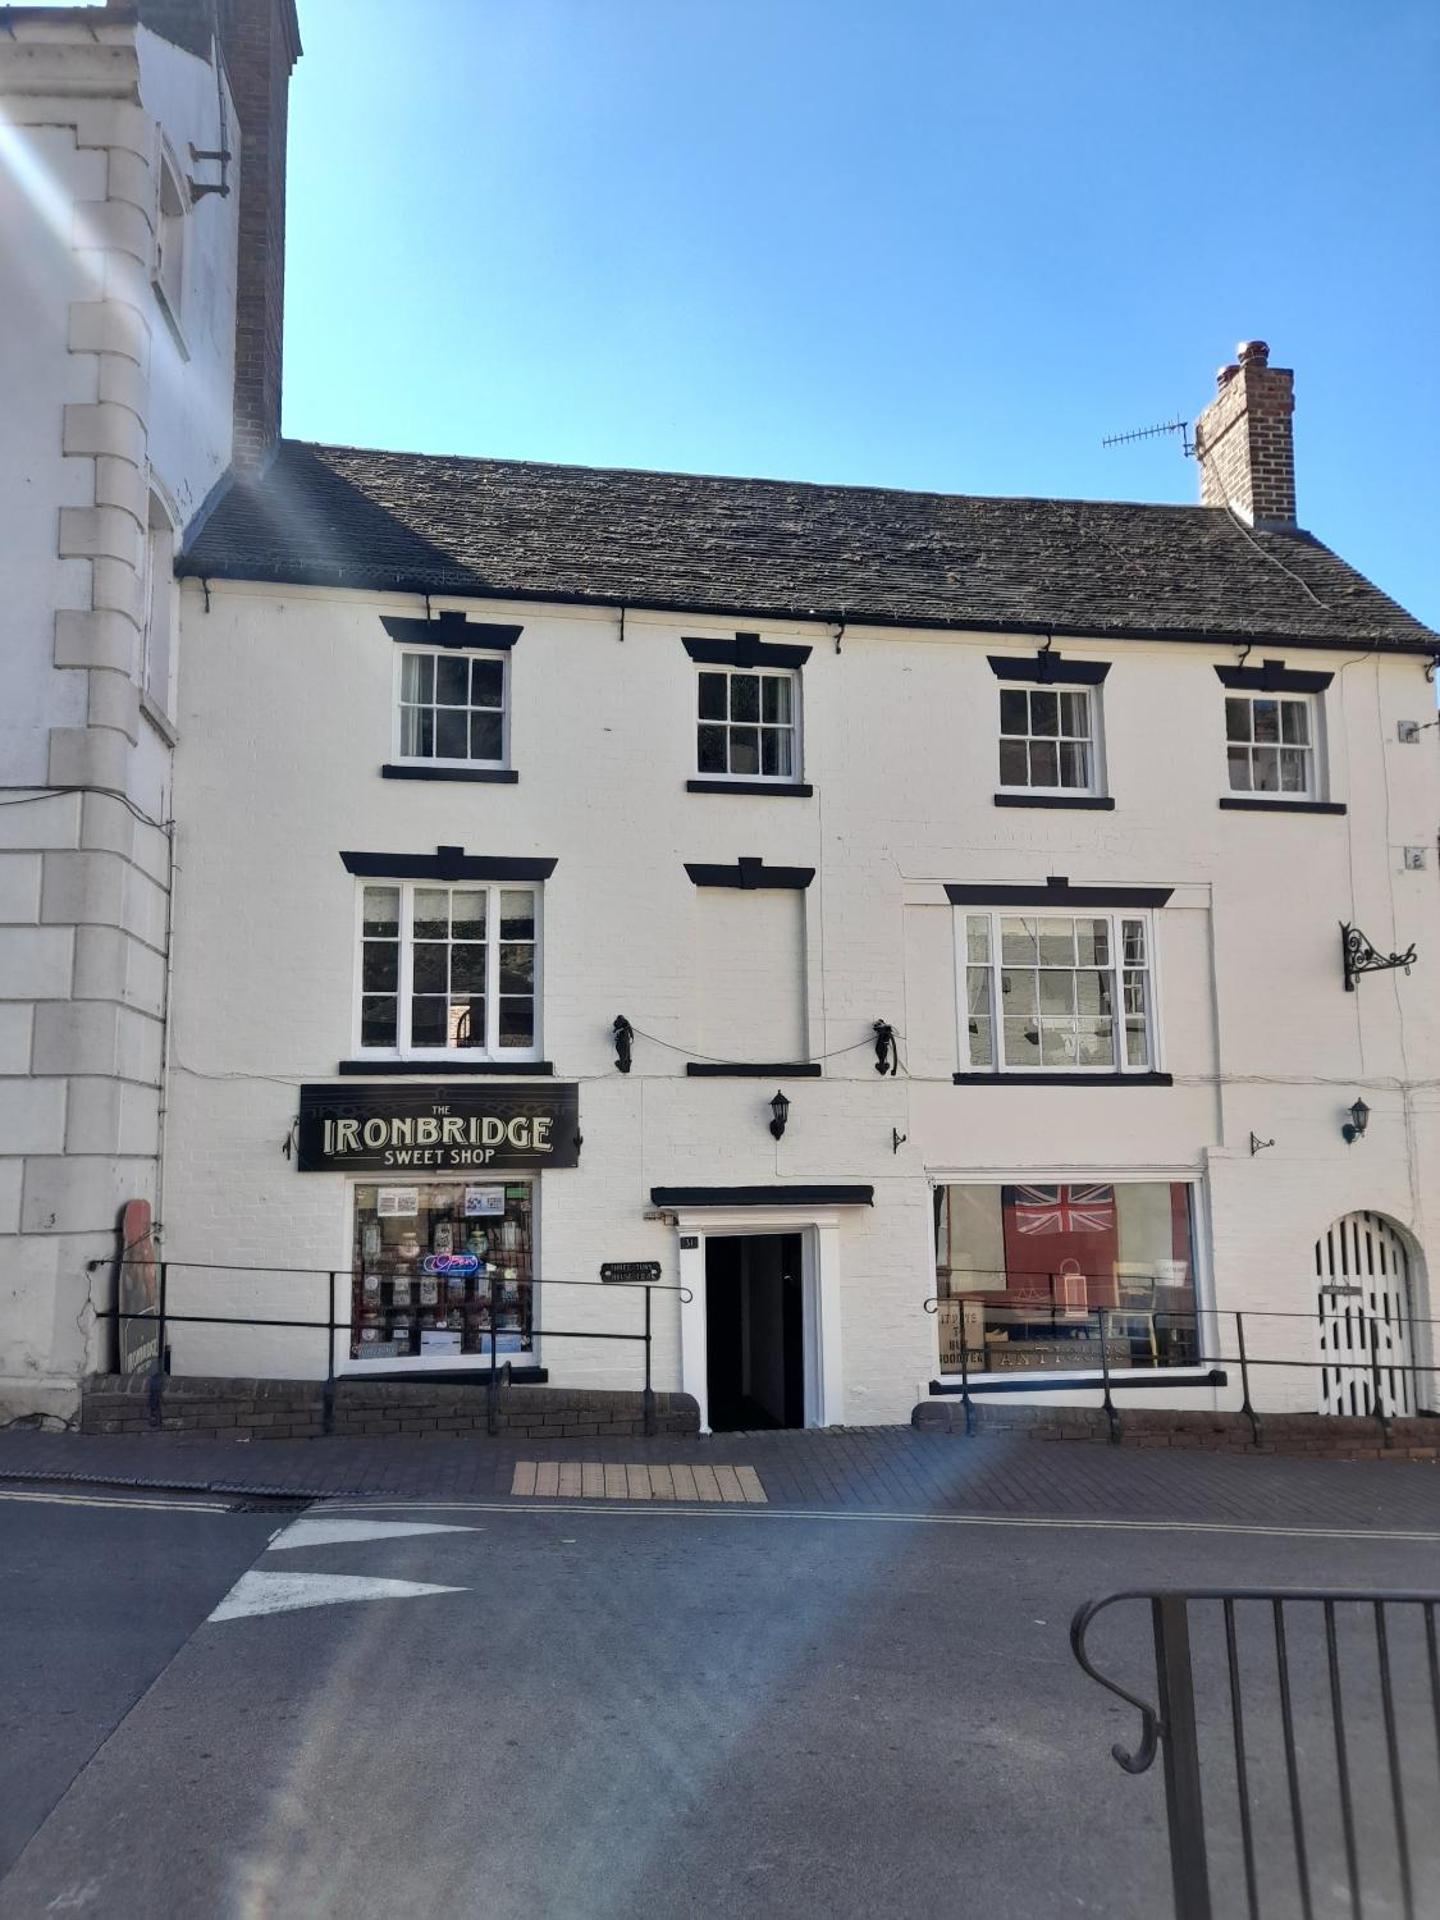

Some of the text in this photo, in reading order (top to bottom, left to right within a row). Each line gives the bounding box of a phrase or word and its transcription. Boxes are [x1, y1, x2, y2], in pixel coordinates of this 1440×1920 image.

[432, 1105, 451, 1115] THE
[323, 1116, 554, 1155] IRONBRIDGE
[384, 1149, 495, 1165] SWEET SHOP
